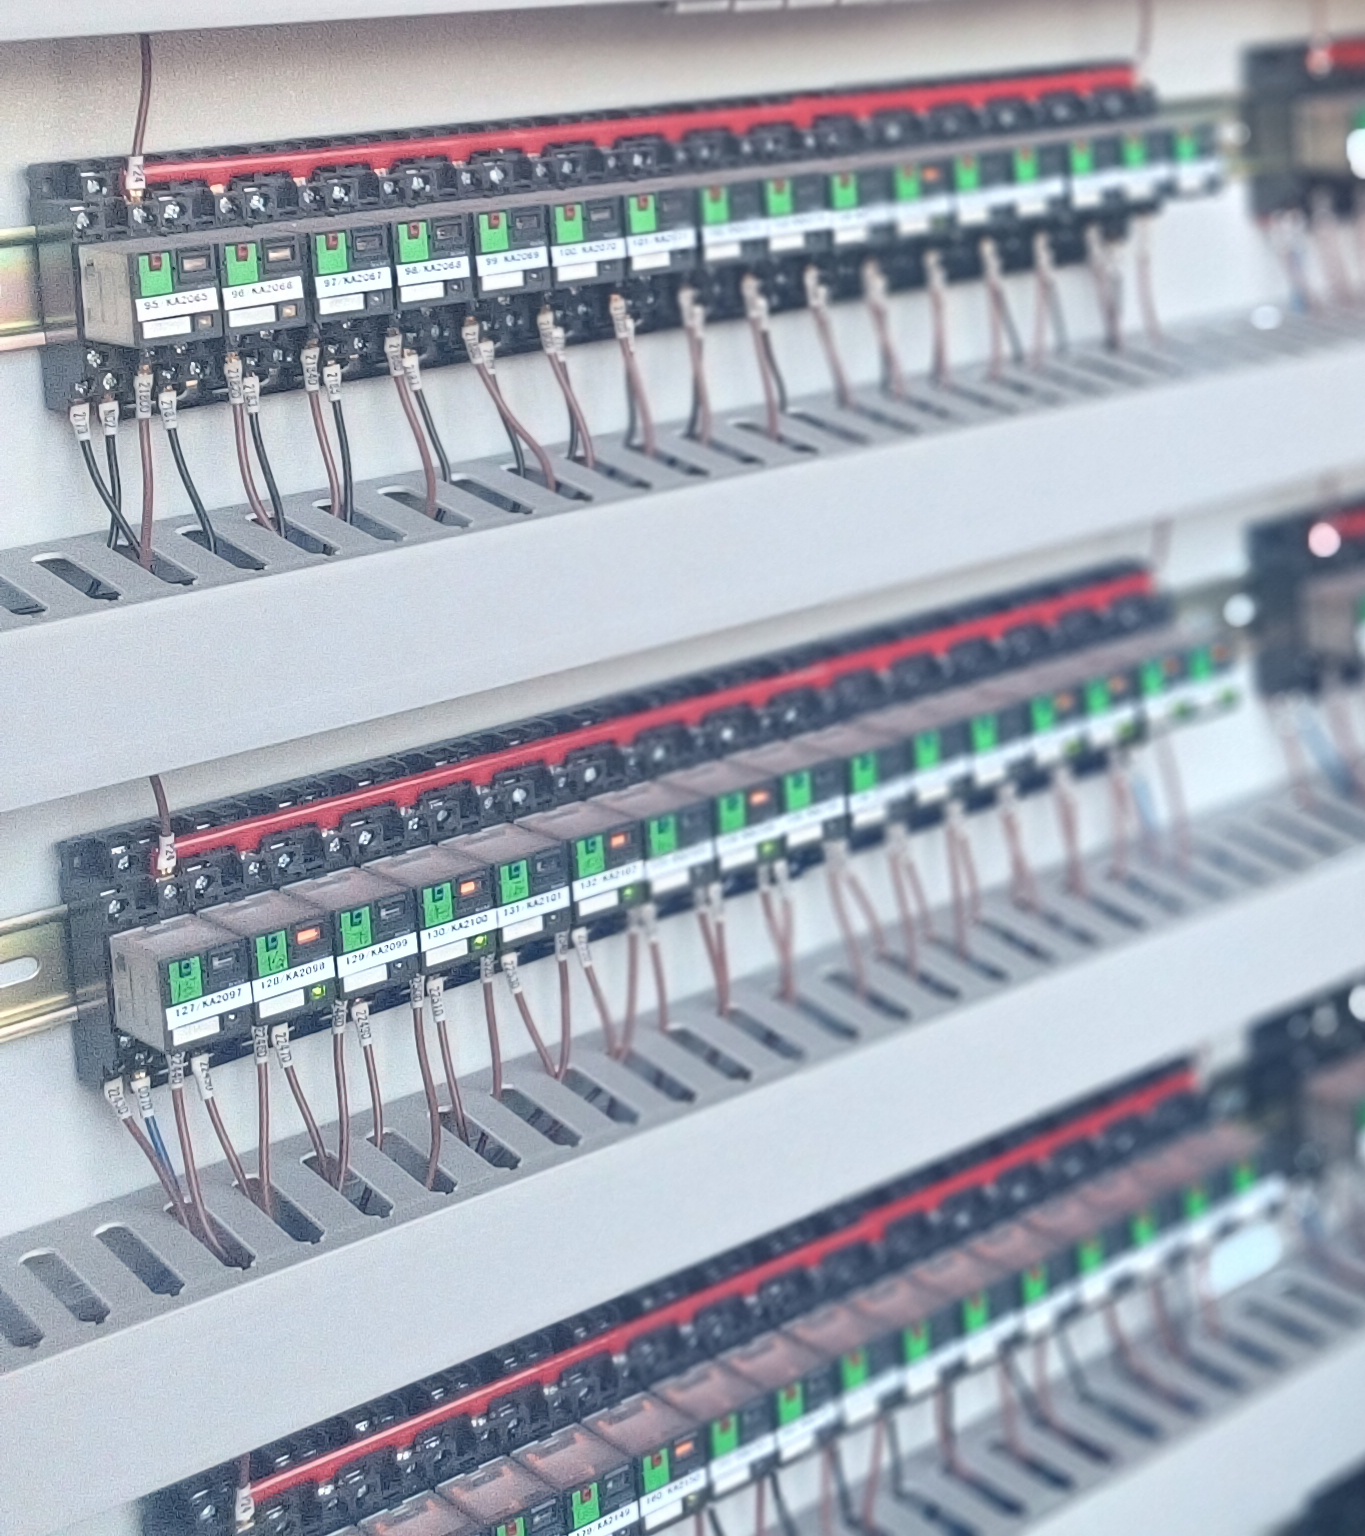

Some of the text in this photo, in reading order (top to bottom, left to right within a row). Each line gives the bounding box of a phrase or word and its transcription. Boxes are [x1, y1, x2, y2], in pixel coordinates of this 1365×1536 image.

[427, 913, 489, 941] 130/KA2100
[346, 938, 409, 966] 129/KA2099
[175, 987, 243, 1017] 127/KA2097
